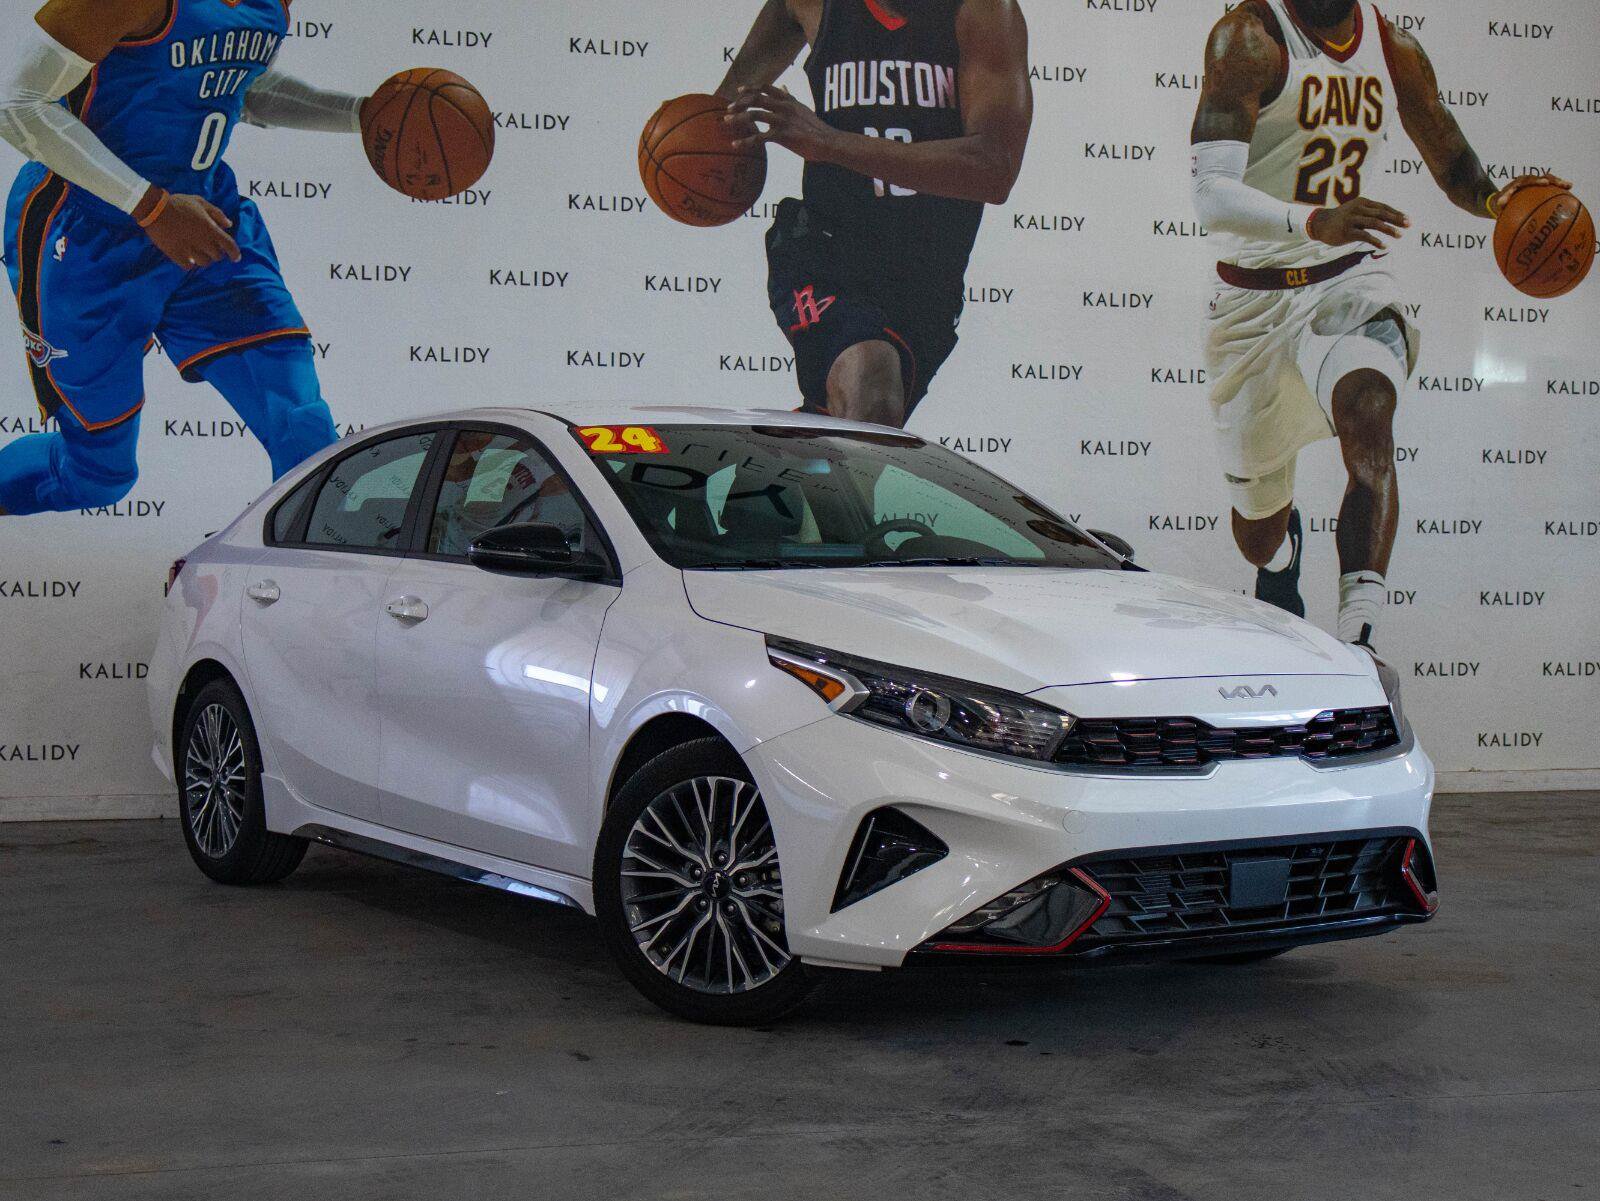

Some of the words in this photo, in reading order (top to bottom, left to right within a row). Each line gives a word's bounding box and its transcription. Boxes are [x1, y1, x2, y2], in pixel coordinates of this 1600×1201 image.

[1088, 0, 1155, 12] KALIDY
[286, 22, 332, 38] IDY
[413, 28, 492, 48] KALIDY
[1489, 22, 1553, 39] KALIDY
[171, 30, 278, 68] OKLAHOM
[570, 38, 648, 57] KALIDY
[1029, 66, 1087, 82] ALIDY
[1155, 73, 1205, 89] KALI
[199, 69, 248, 99] CITY
[824, 60, 956, 112] HOUSTON
[1297, 74, 1383, 133] CAVS
[1437, 91, 1488, 106] ALIDY
[1551, 97, 1600, 113] KALID
[493, 112, 569, 130] KALIDY
[191, 112, 227, 171] 0
[1085, 143, 1155, 160] KALIDY
[1293, 135, 1368, 206] 23
[1385, 160, 1422, 174] IDY
[246, 181, 331, 202] KALIDY
[569, 191, 649, 212] KALIDY
[1014, 214, 1084, 231] KALIDY
[1422, 233, 1486, 249] KALIDY
[331, 264, 411, 282] KALIDY
[490, 270, 568, 287] KALIDY
[1286, 269, 1308, 287] CLE
[646, 275, 721, 293] KALIDY
[963, 287, 1013, 304] LIDY
[1083, 292, 1153, 308] KALIDY
[1485, 307, 1549, 323] KALIDY
[410, 346, 489, 363] KALIDY
[567, 351, 645, 367] KALIDY
[720, 355, 795, 373] KALIDY
[1012, 364, 1083, 380] KALIDY
[1151, 368, 1206, 384] KALID
[1419, 376, 1483, 391] KALIDY
[1547, 381, 1600, 395] KALID
[165, 421, 248, 437] KALIDY
[580, 427, 662, 452] 24
[940, 437, 1012, 453] KALIDY
[1081, 440, 1151, 456] KALIDY
[1483, 449, 1547, 464] KALIDY
[81, 501, 165, 516] KALIDY
[1150, 516, 1218, 530] KALIDY
[1417, 520, 1482, 534] KALIDY
[1545, 521, 1600, 536] KALID
[0, 582, 80, 597] KALIDY
[1387, 591, 1416, 605] IDY
[1480, 592, 1544, 605] KALIDY
[80, 663, 148, 679] KALID
[1415, 662, 1480, 676] KALIDY
[1479, 733, 1543, 747] KALIDY
